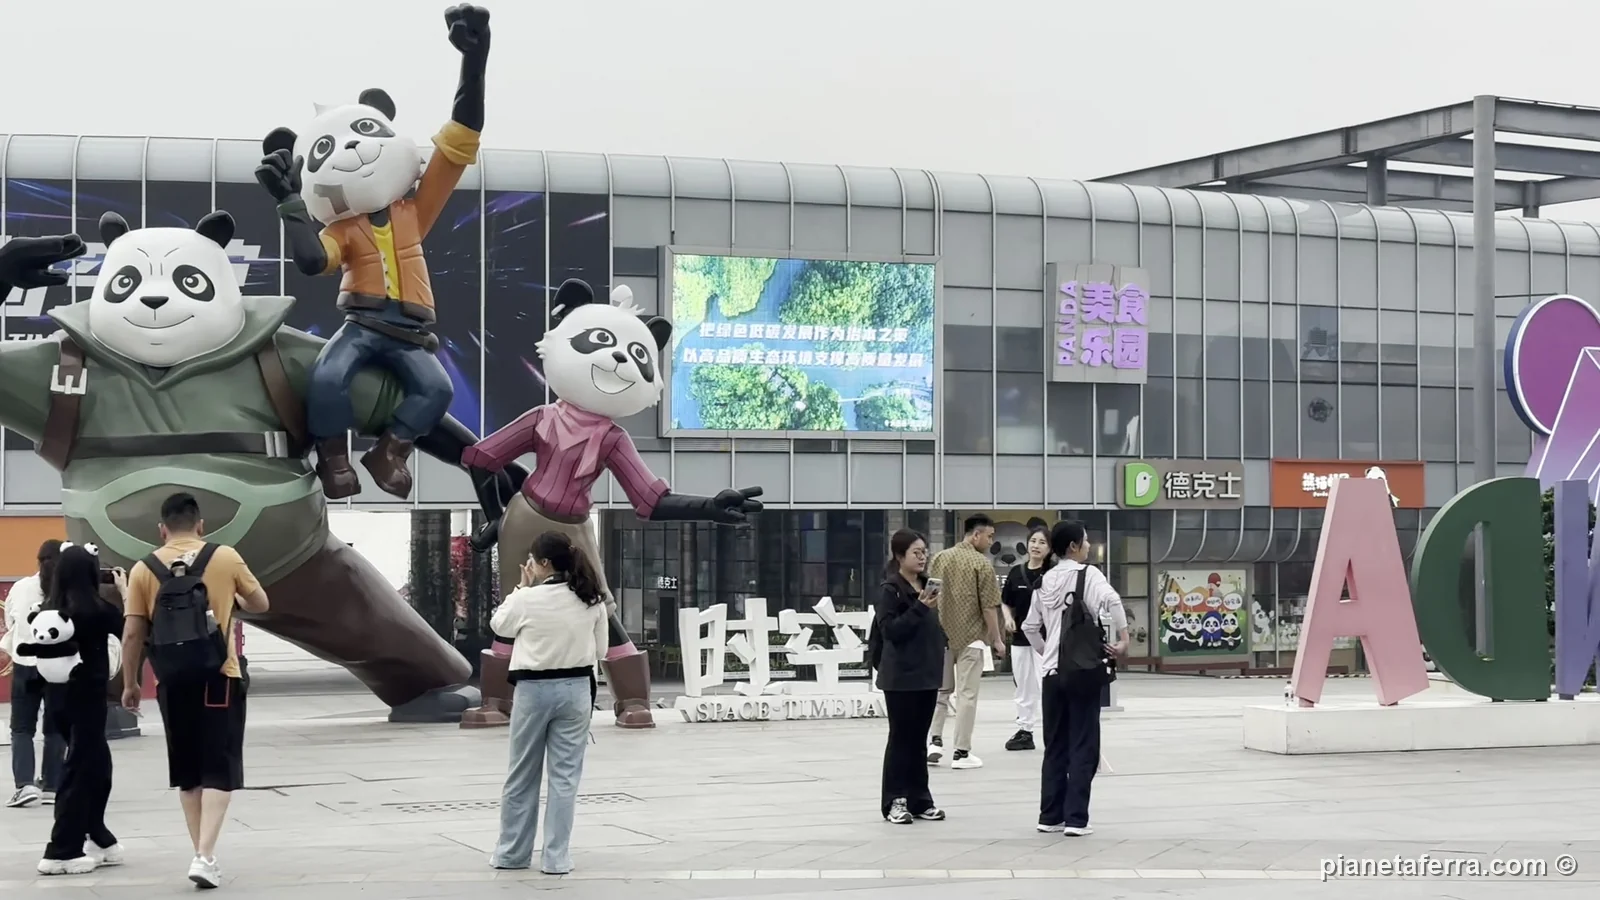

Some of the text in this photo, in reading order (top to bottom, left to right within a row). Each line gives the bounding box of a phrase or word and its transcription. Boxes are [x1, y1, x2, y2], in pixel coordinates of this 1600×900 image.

[1058, 280, 1078, 366] PANDA
[1080, 281, 1149, 325] 美食
[1080, 326, 1147, 370] 乐园
[1164, 471, 1242, 499] 德克士
[850, 698, 885, 719] PA
